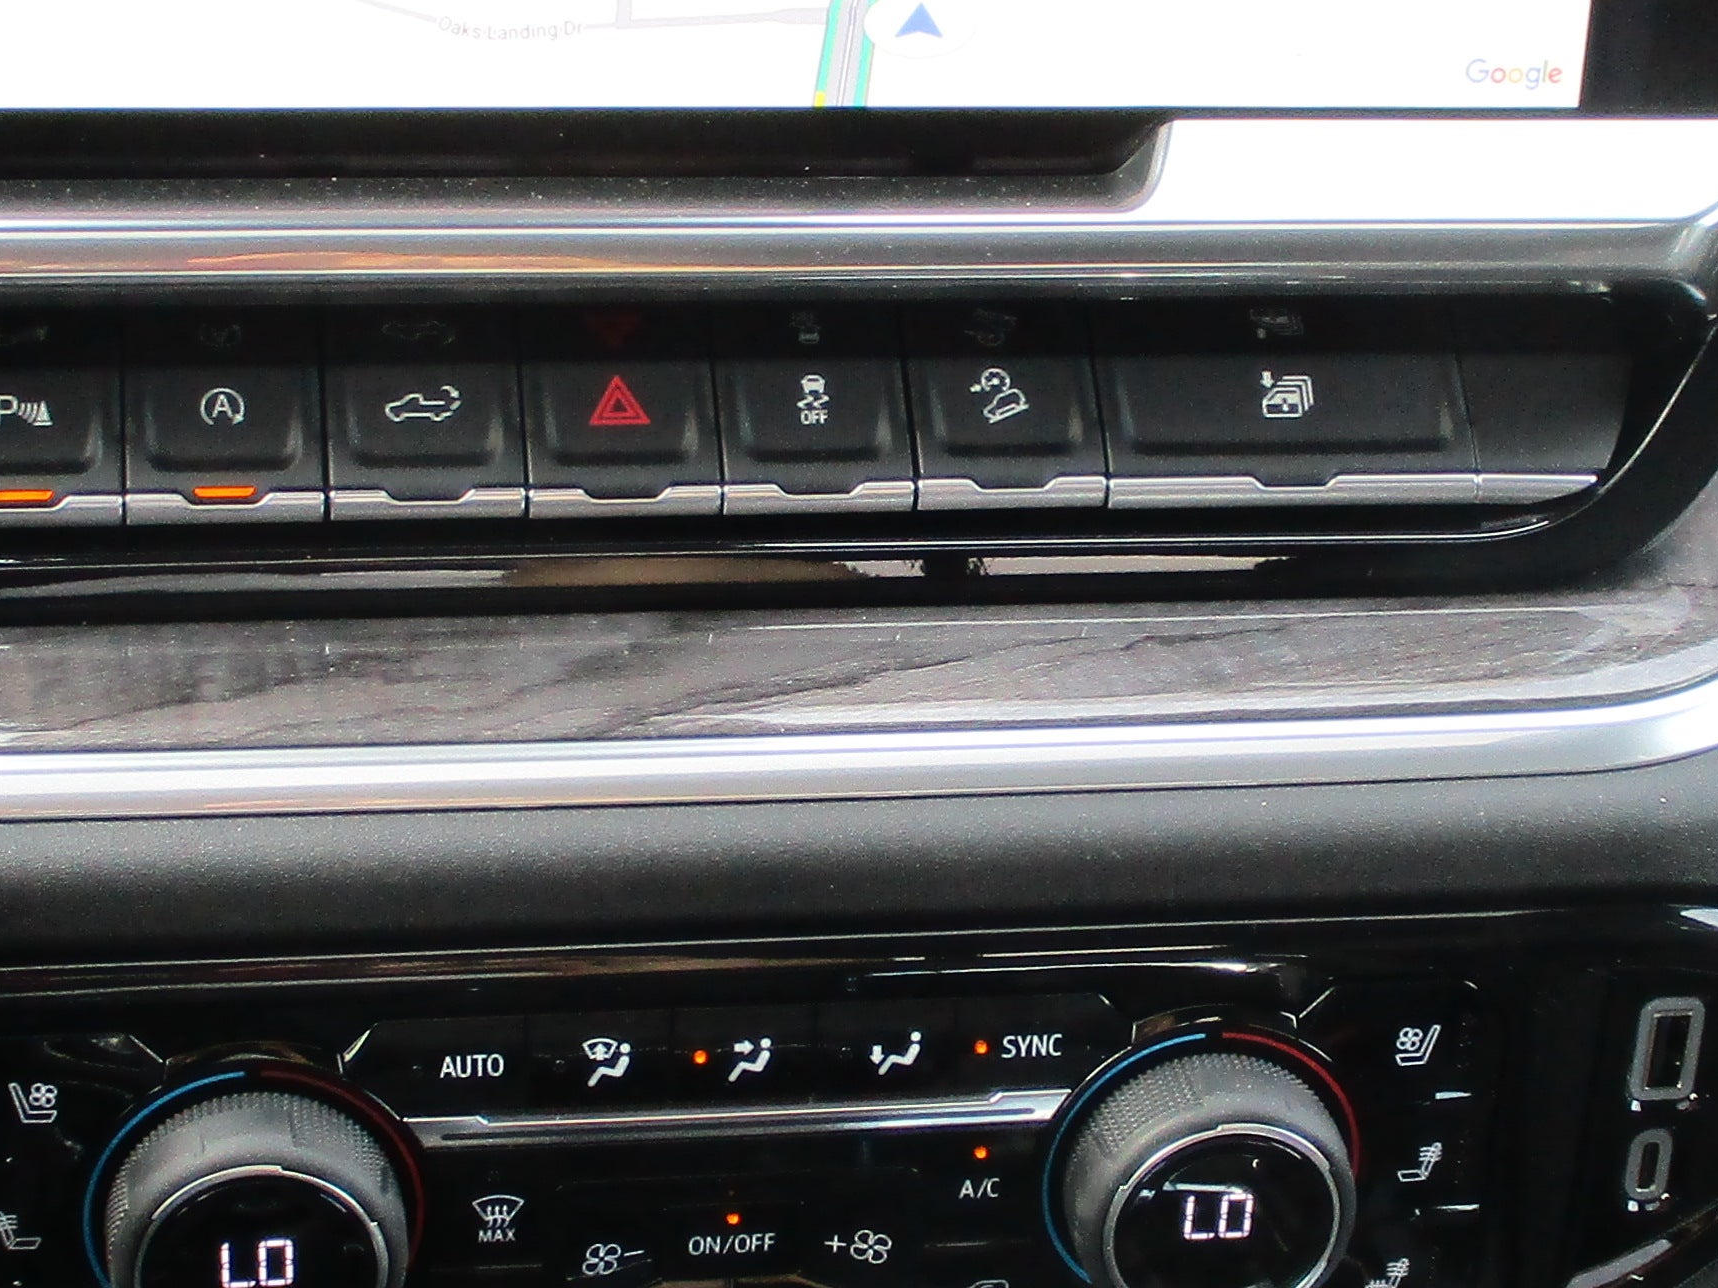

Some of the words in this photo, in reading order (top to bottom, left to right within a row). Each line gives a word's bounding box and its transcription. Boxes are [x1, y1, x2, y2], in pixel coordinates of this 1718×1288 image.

[437, 15, 482, 40] Oaks
[486, 23, 559, 42] Landing
[563, 20, 583, 36] Dr
[1465, 57, 1563, 91] Google
[800, 409, 829, 425] OFF
[1001, 1033, 1063, 1059] SYNC
[439, 1053, 505, 1079] AUTO
[958, 1177, 1001, 1200] A/C
[478, 1228, 516, 1243] MAX
[688, 1232, 776, 1256] ON/OFF
